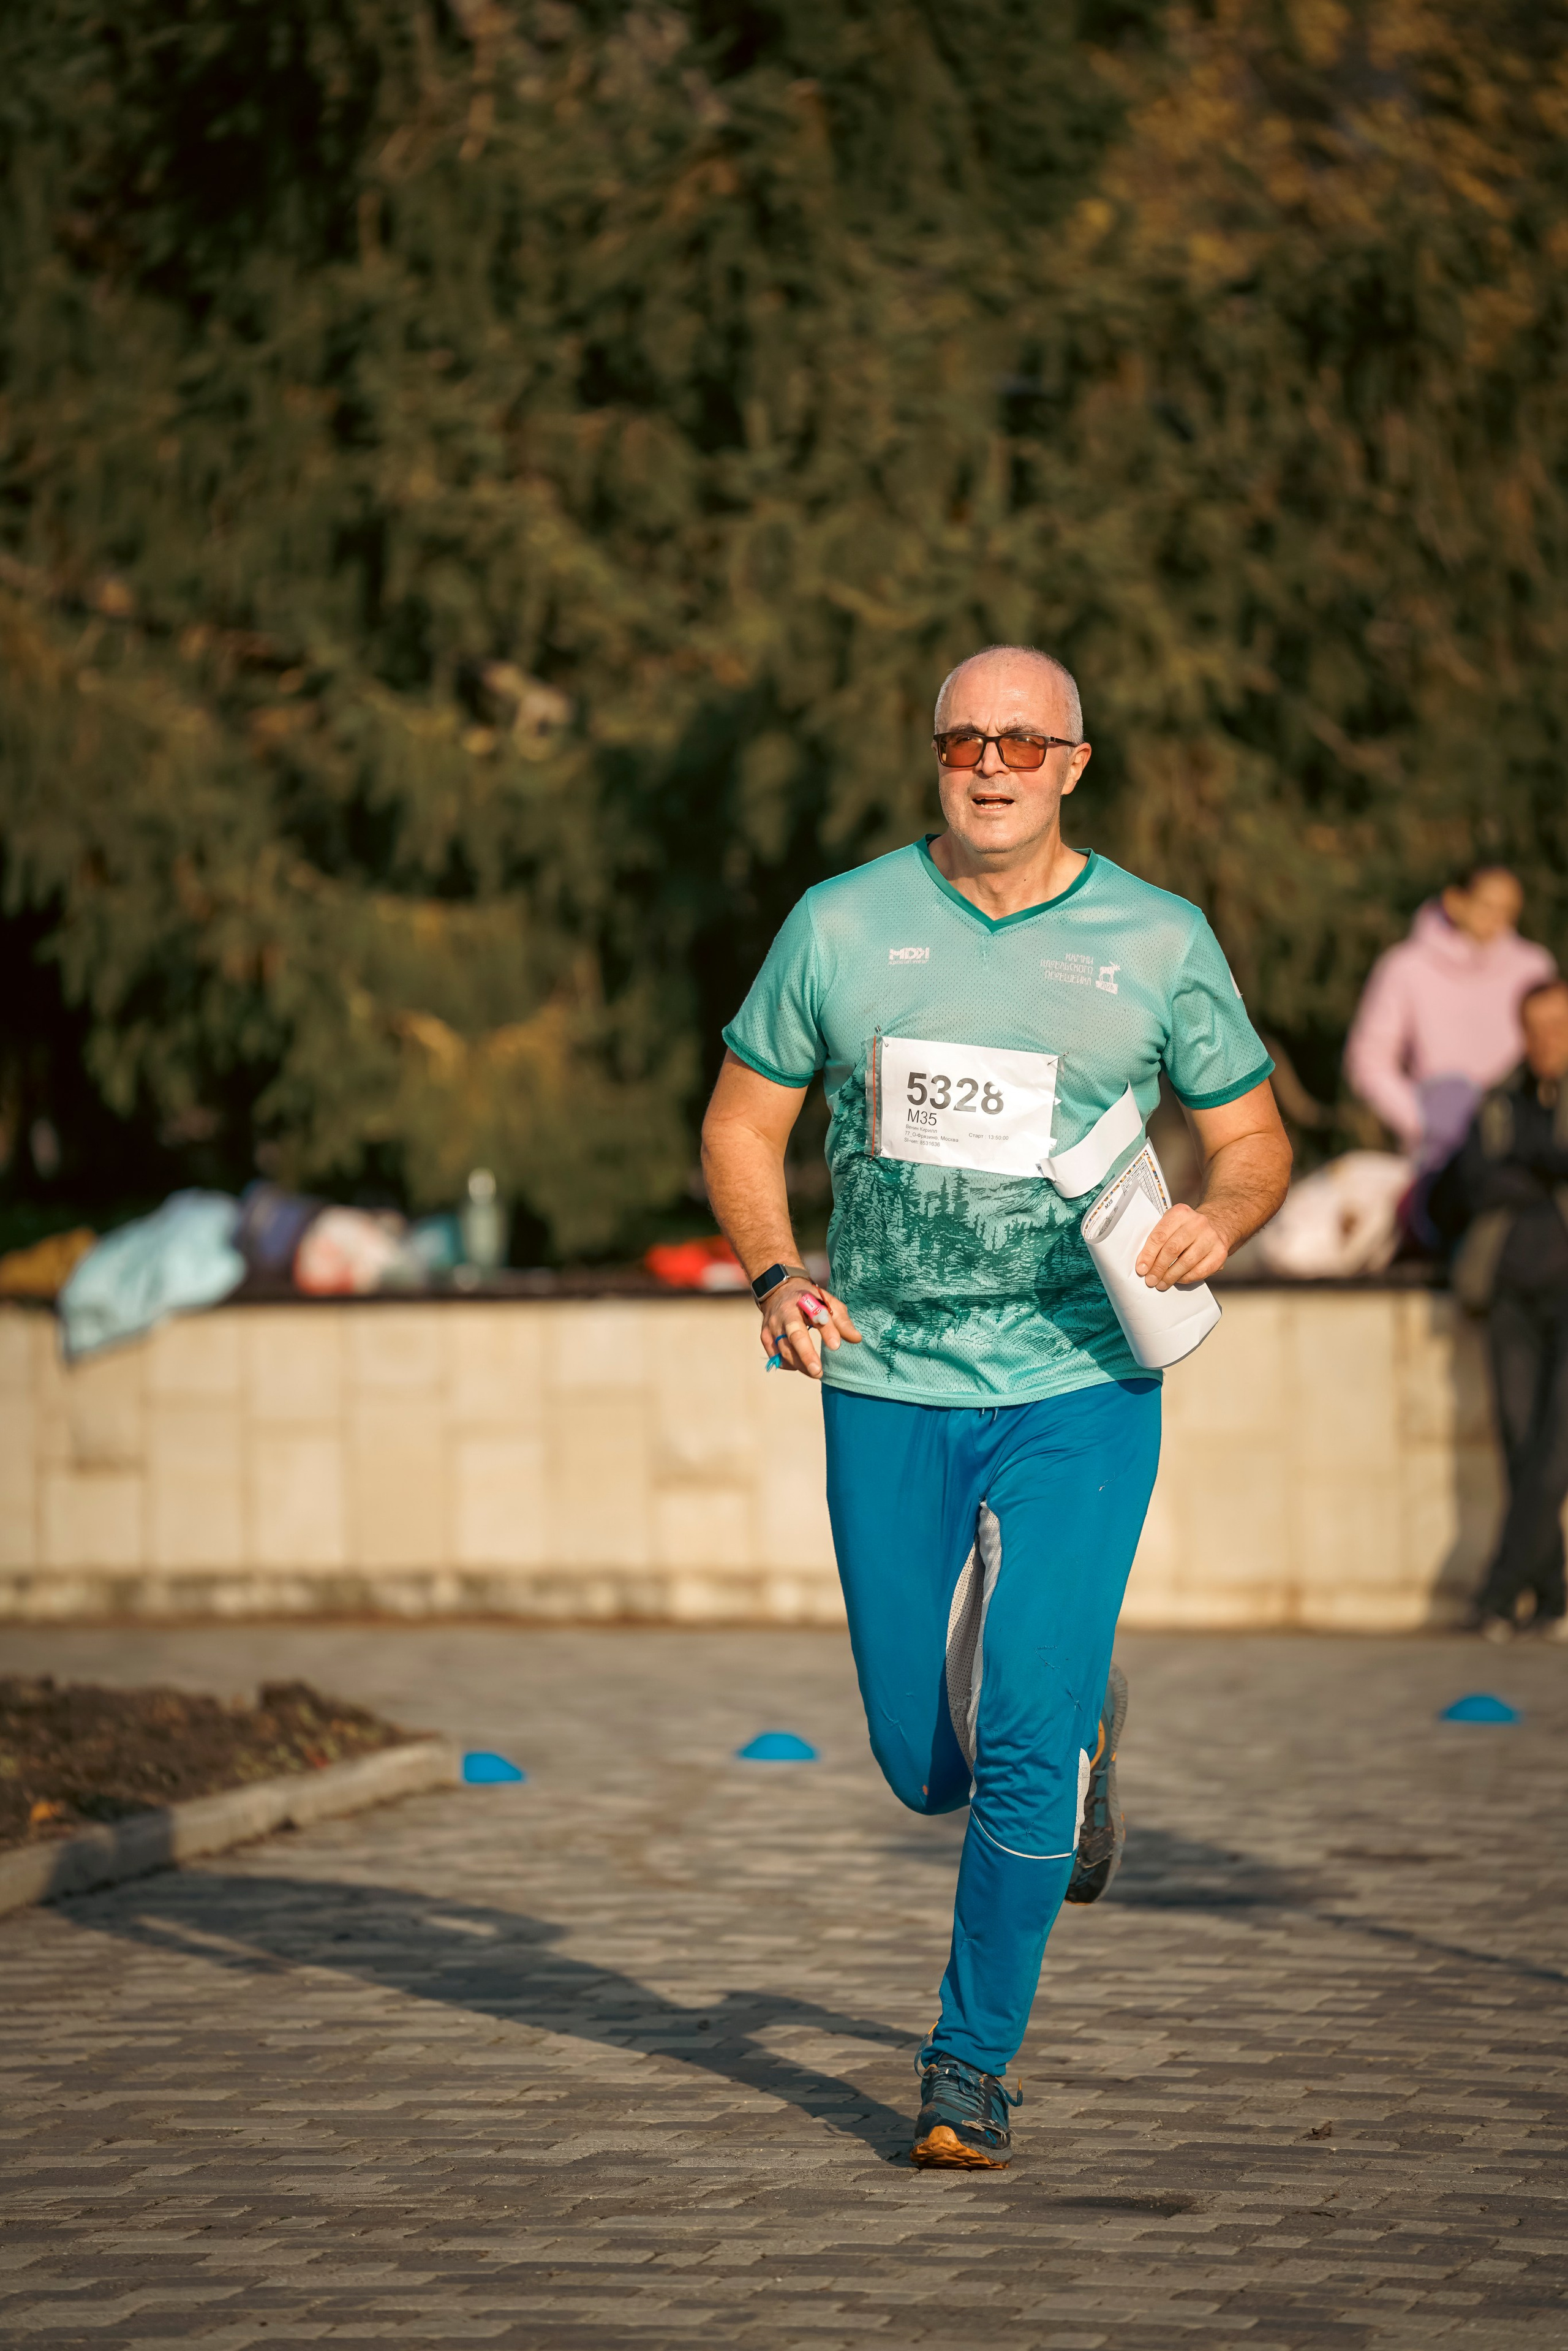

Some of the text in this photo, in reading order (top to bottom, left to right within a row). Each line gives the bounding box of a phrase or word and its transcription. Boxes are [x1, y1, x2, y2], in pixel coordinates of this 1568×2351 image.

[1065, 953, 1093, 964] КАМНИ
[1041, 959, 1093, 975] КАРЕЛЬСКОГО
[1045, 970, 1091, 985] ПЕРЕШЕЙКА
[907, 1072, 1004, 1115] 5328
[908, 1109, 937, 1126] M35
